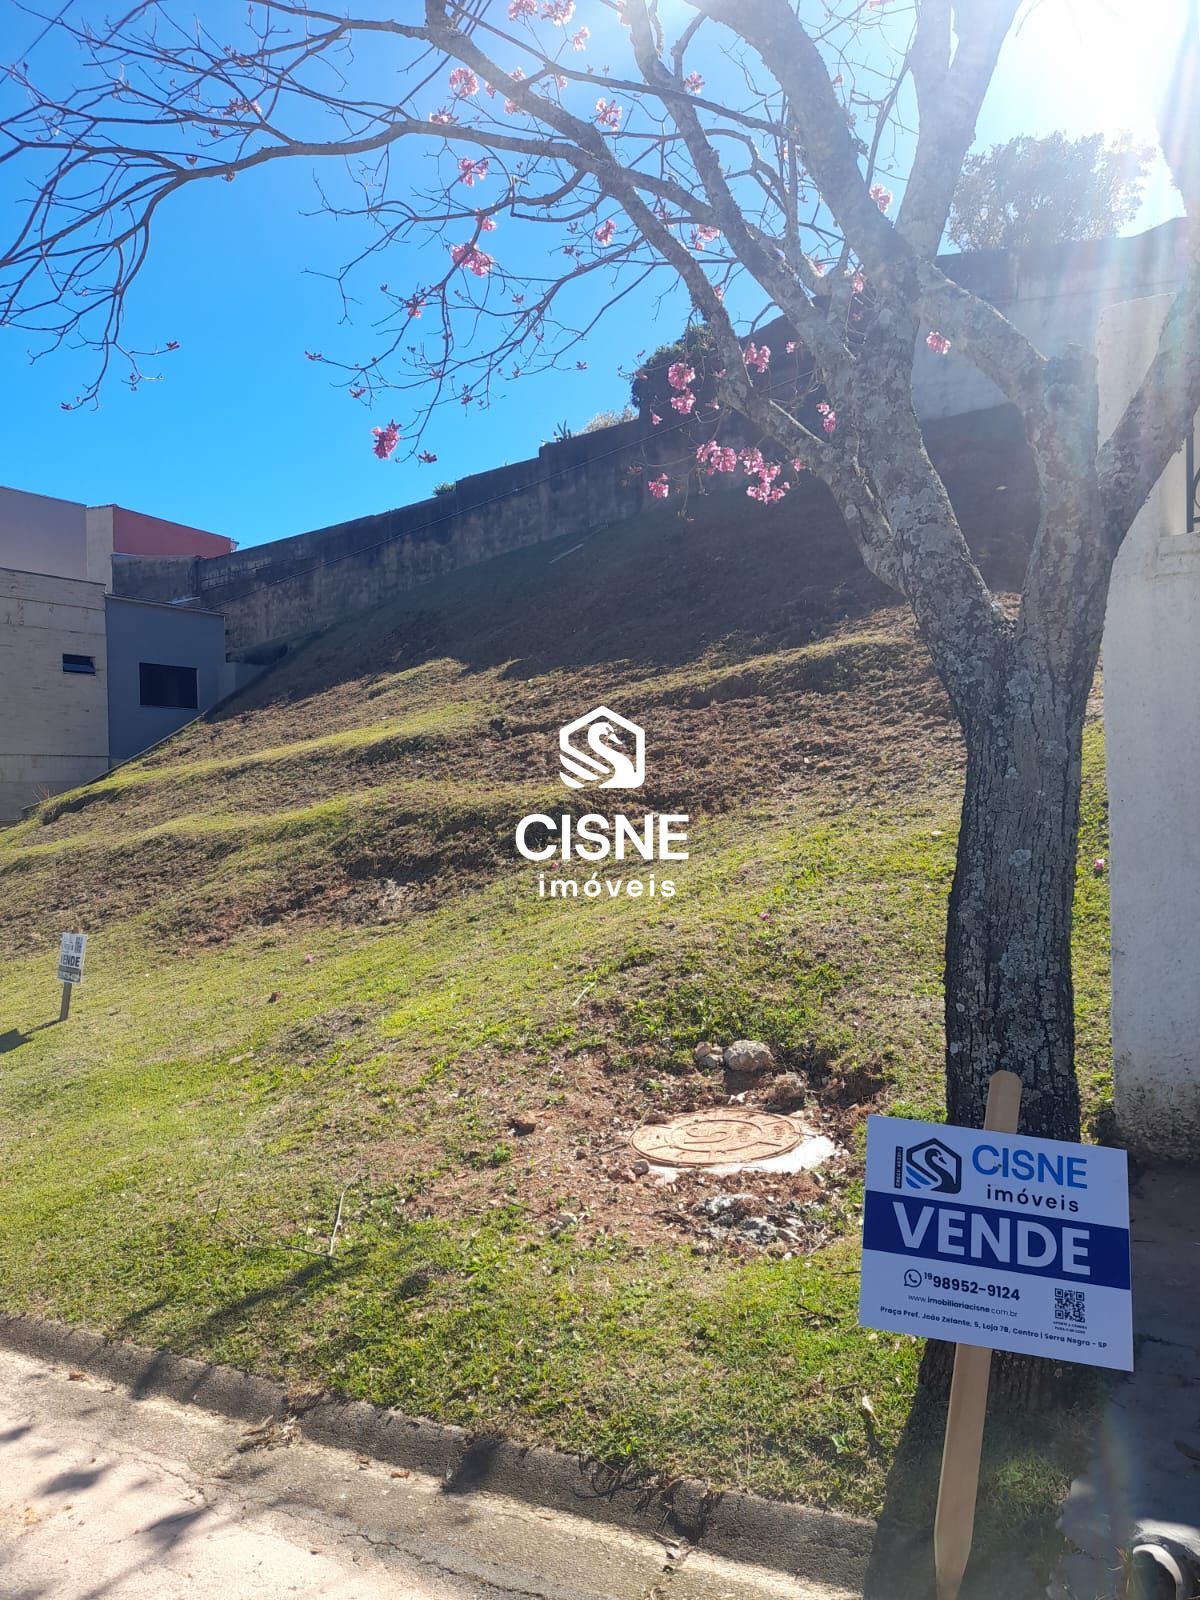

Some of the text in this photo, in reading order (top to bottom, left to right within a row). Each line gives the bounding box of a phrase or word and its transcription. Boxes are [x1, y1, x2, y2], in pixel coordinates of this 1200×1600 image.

[972, 1144, 1088, 1189] CISNE
[987, 1184, 1080, 1212] imóveis
[892, 1201, 1091, 1275] VENDE
[880, 1305, 902, 1316] Praça
[903, 1310, 921, 1319] Pref.
[922, 1313, 940, 1322] João
[982, 1323, 998, 1332] Loja
[1013, 1328, 1039, 1338] Centro
[1044, 1333, 1065, 1343] Serra
[1098, 1341, 1107, 1349] SP
